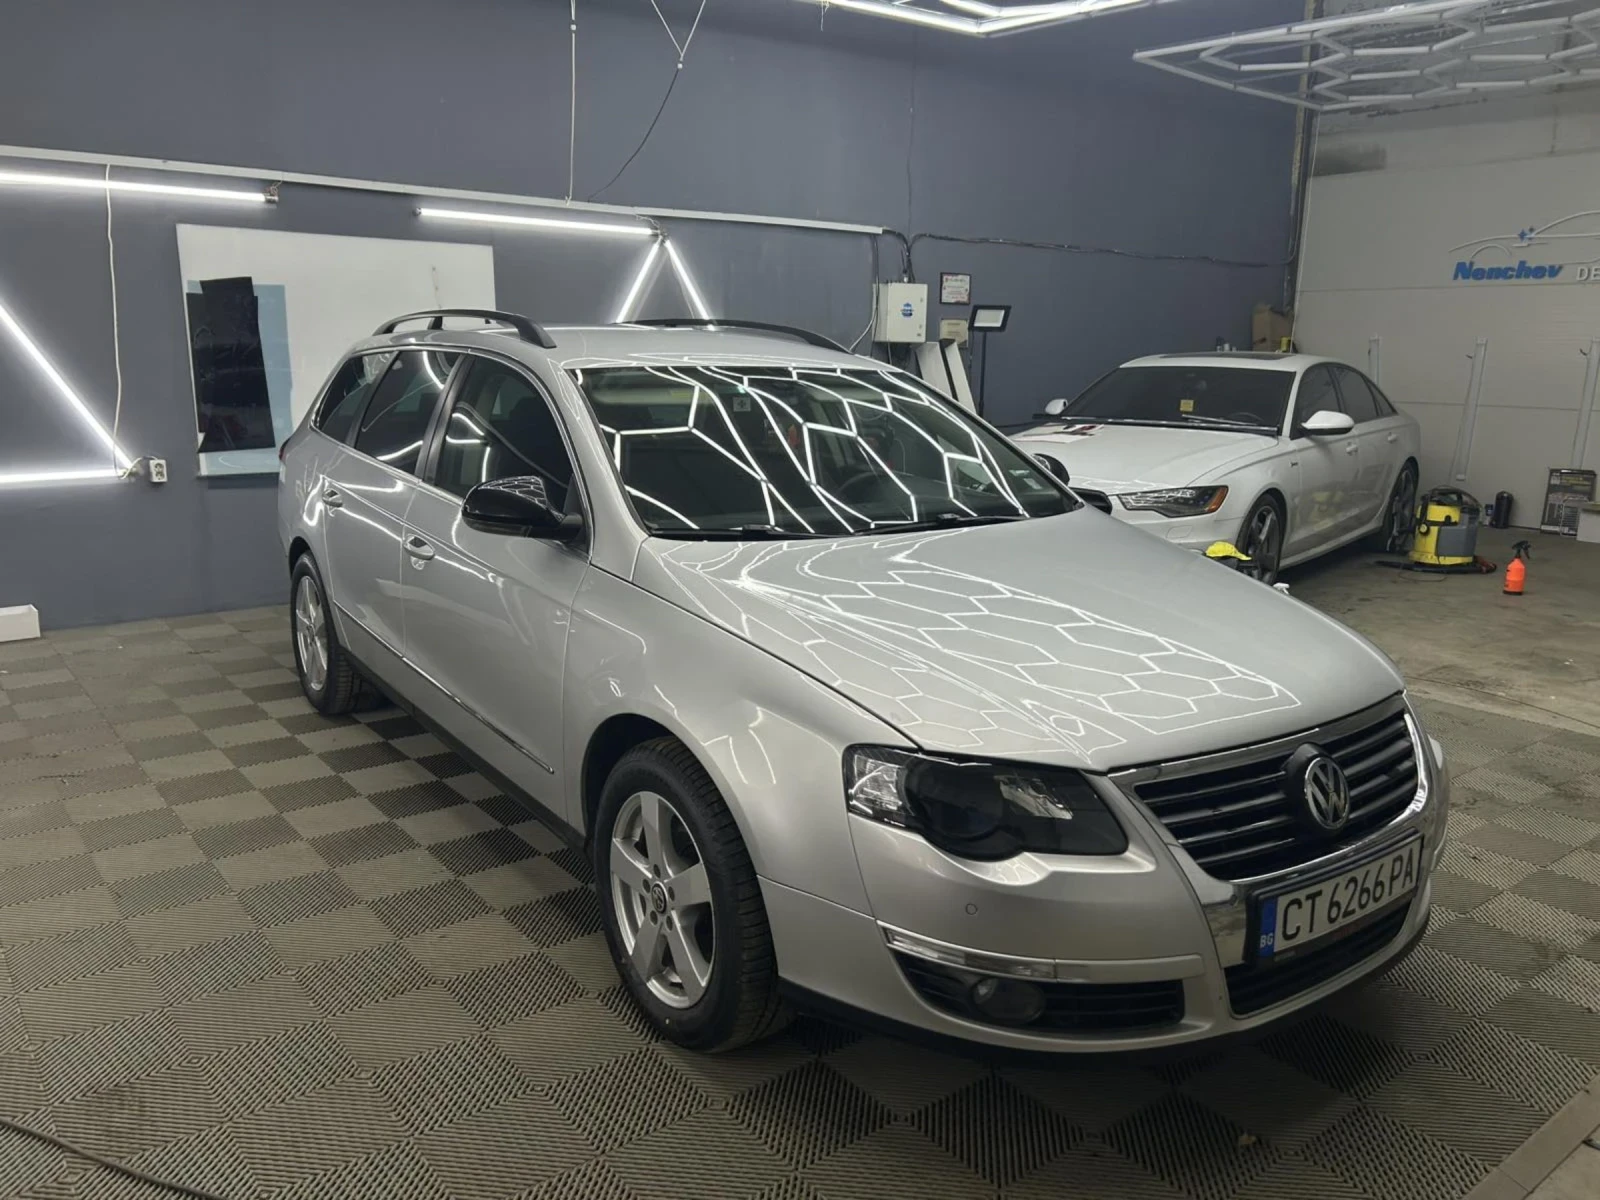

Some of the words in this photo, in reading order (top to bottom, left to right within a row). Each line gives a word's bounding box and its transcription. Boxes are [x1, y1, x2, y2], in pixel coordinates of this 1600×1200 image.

[1453, 260, 1563, 280] Nenchev
[1576, 266, 1600, 281] DE
[1260, 932, 1274, 948] BG
